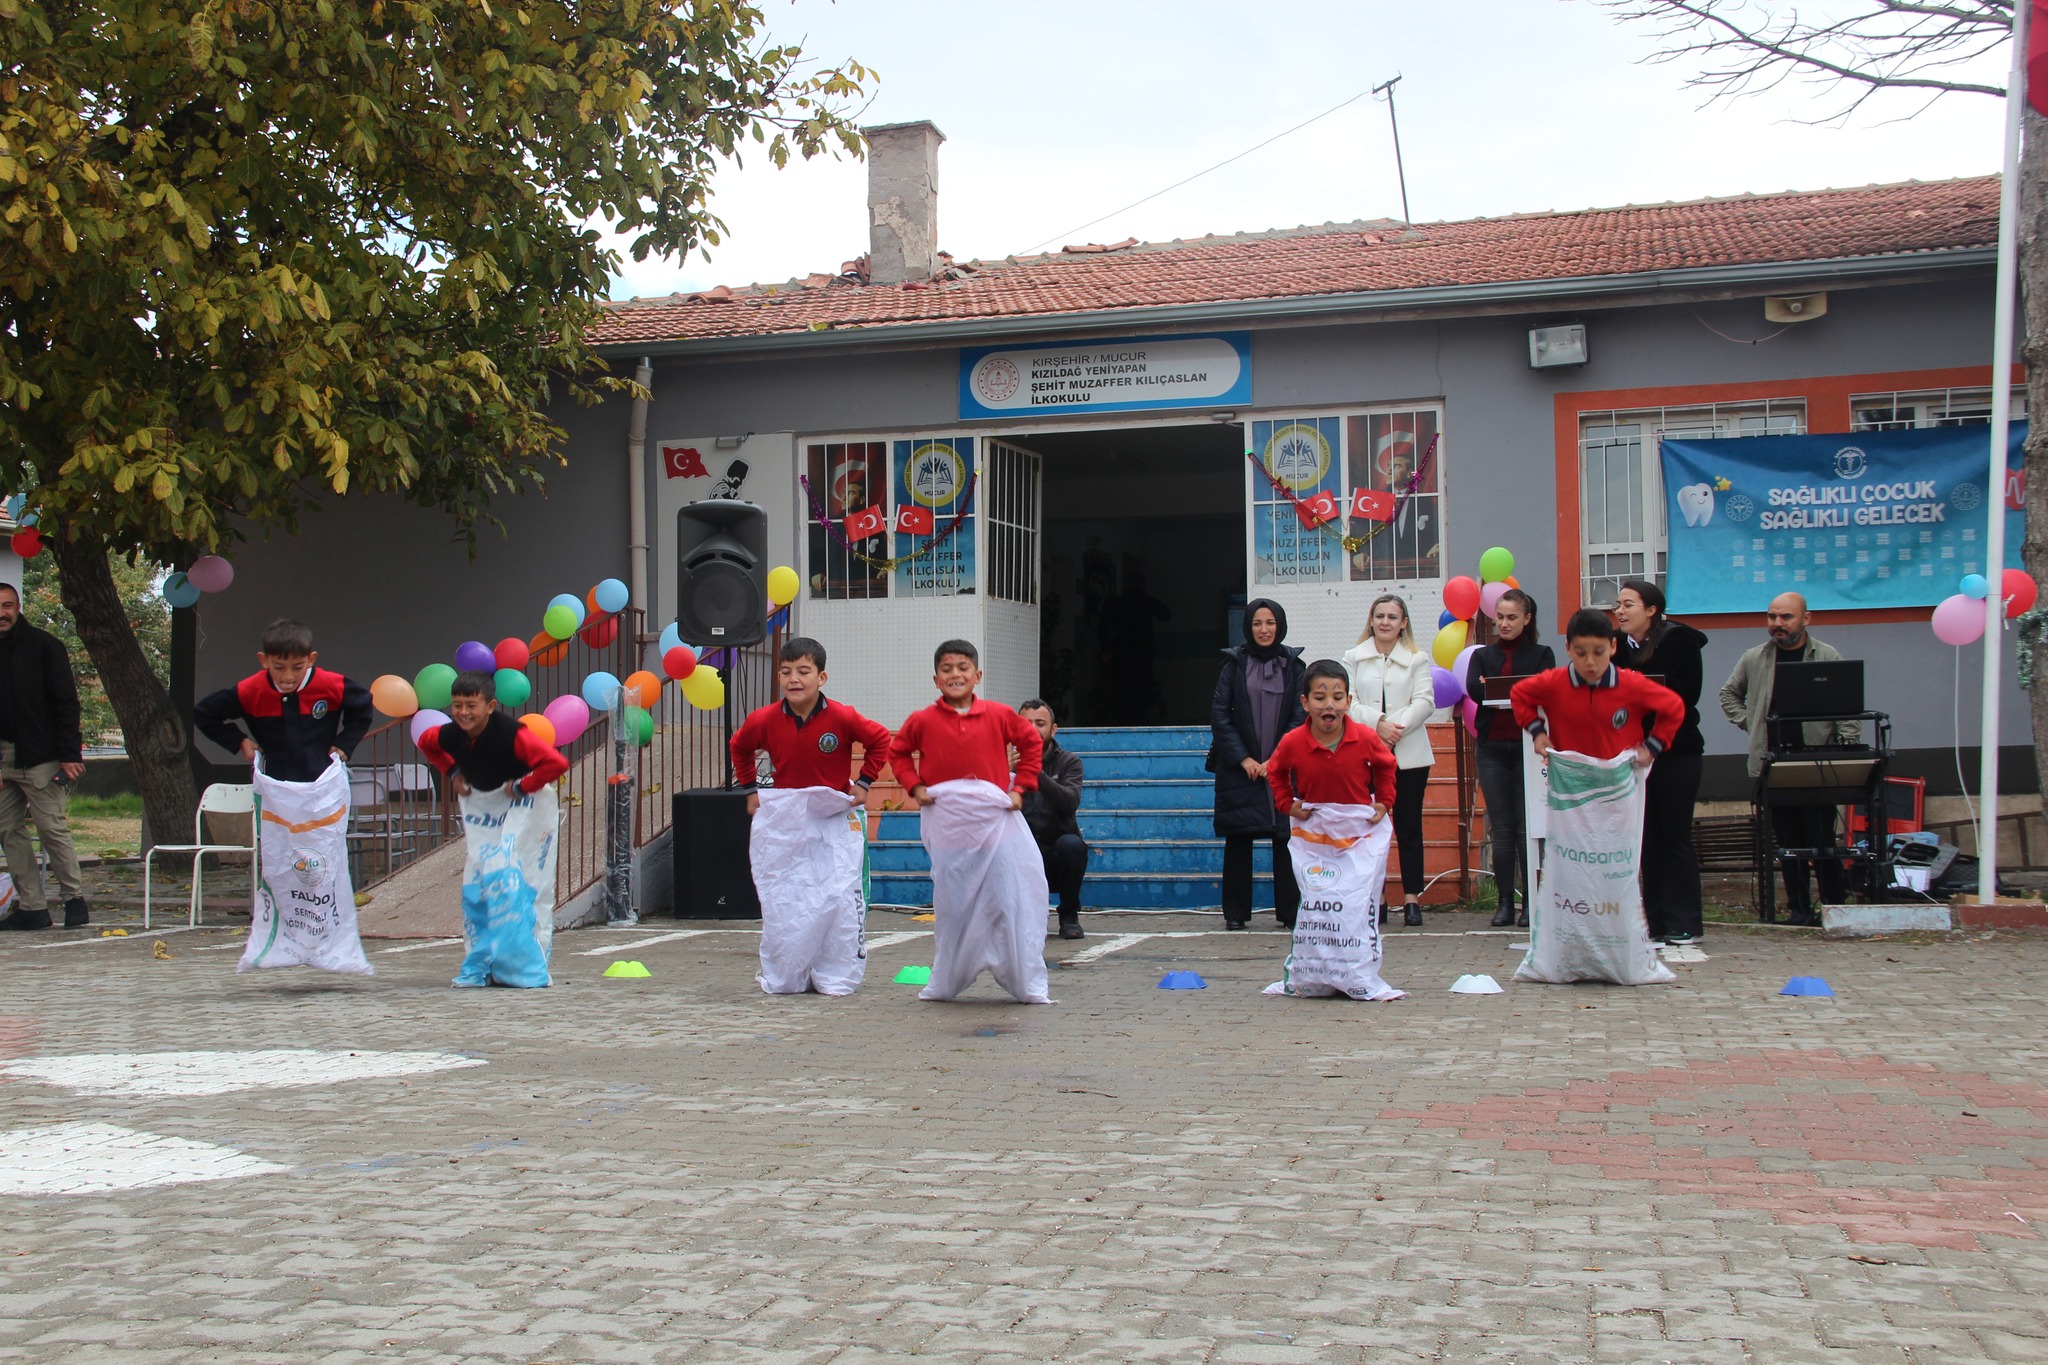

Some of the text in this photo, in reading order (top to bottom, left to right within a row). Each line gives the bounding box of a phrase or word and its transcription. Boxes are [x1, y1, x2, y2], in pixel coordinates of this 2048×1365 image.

[1032, 354, 1091, 368] KIRŞEHİR
[1100, 352, 1147, 363] MUCUR
[1031, 363, 1147, 379] KIZILDAĞ YENİYAPAN
[1031, 373, 1208, 393] ŞEHİT MUZAFFER KILIÇASLAN
[1031, 392, 1091, 405] İLKOKULU
[1768, 480, 1936, 507] SAĞLIKLI ÇOCUK
[1760, 503, 1946, 530] SAĞLIKLI GELECEK
[1266, 552, 1331, 563] KLIÇASLAN
[912, 578, 961, 589] LKOKULU
[1593, 901, 1620, 916] UN
